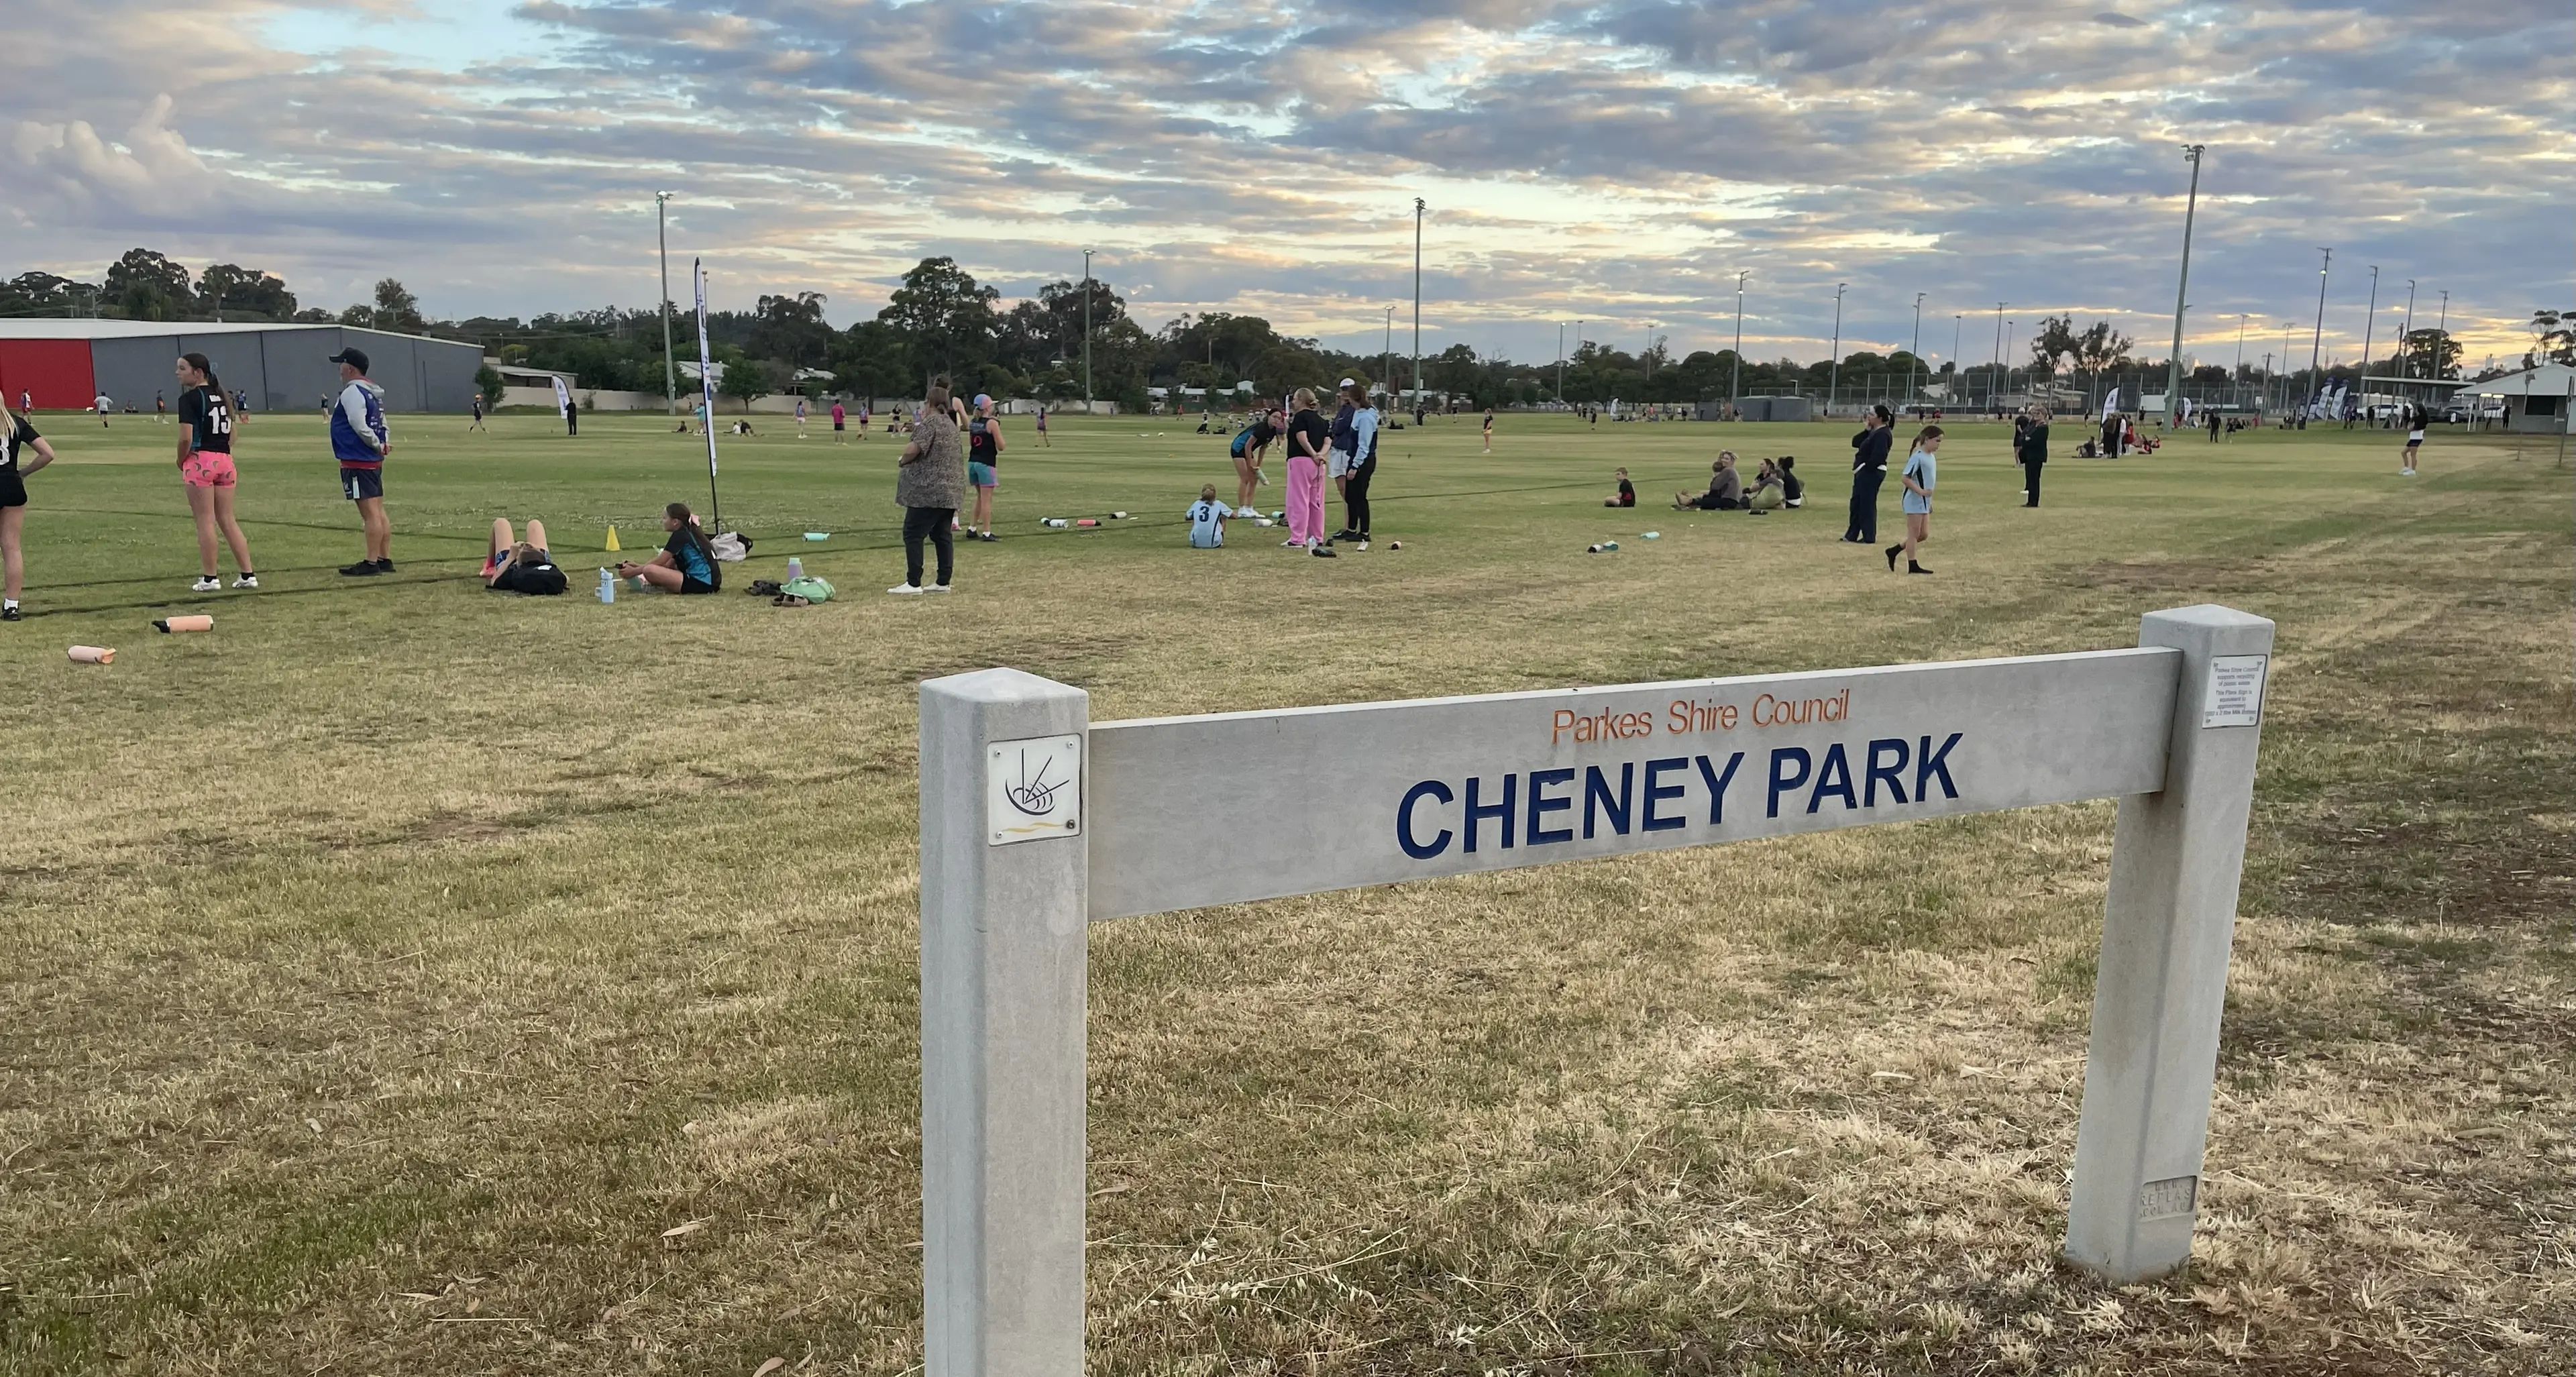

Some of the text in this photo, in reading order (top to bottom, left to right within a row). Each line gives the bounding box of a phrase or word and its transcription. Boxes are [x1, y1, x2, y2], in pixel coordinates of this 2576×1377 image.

[1198, 505, 1210, 522] 3
[1552, 689, 1849, 745] Parkes Shire Council
[1396, 732, 1964, 860] CHENEY PARK
